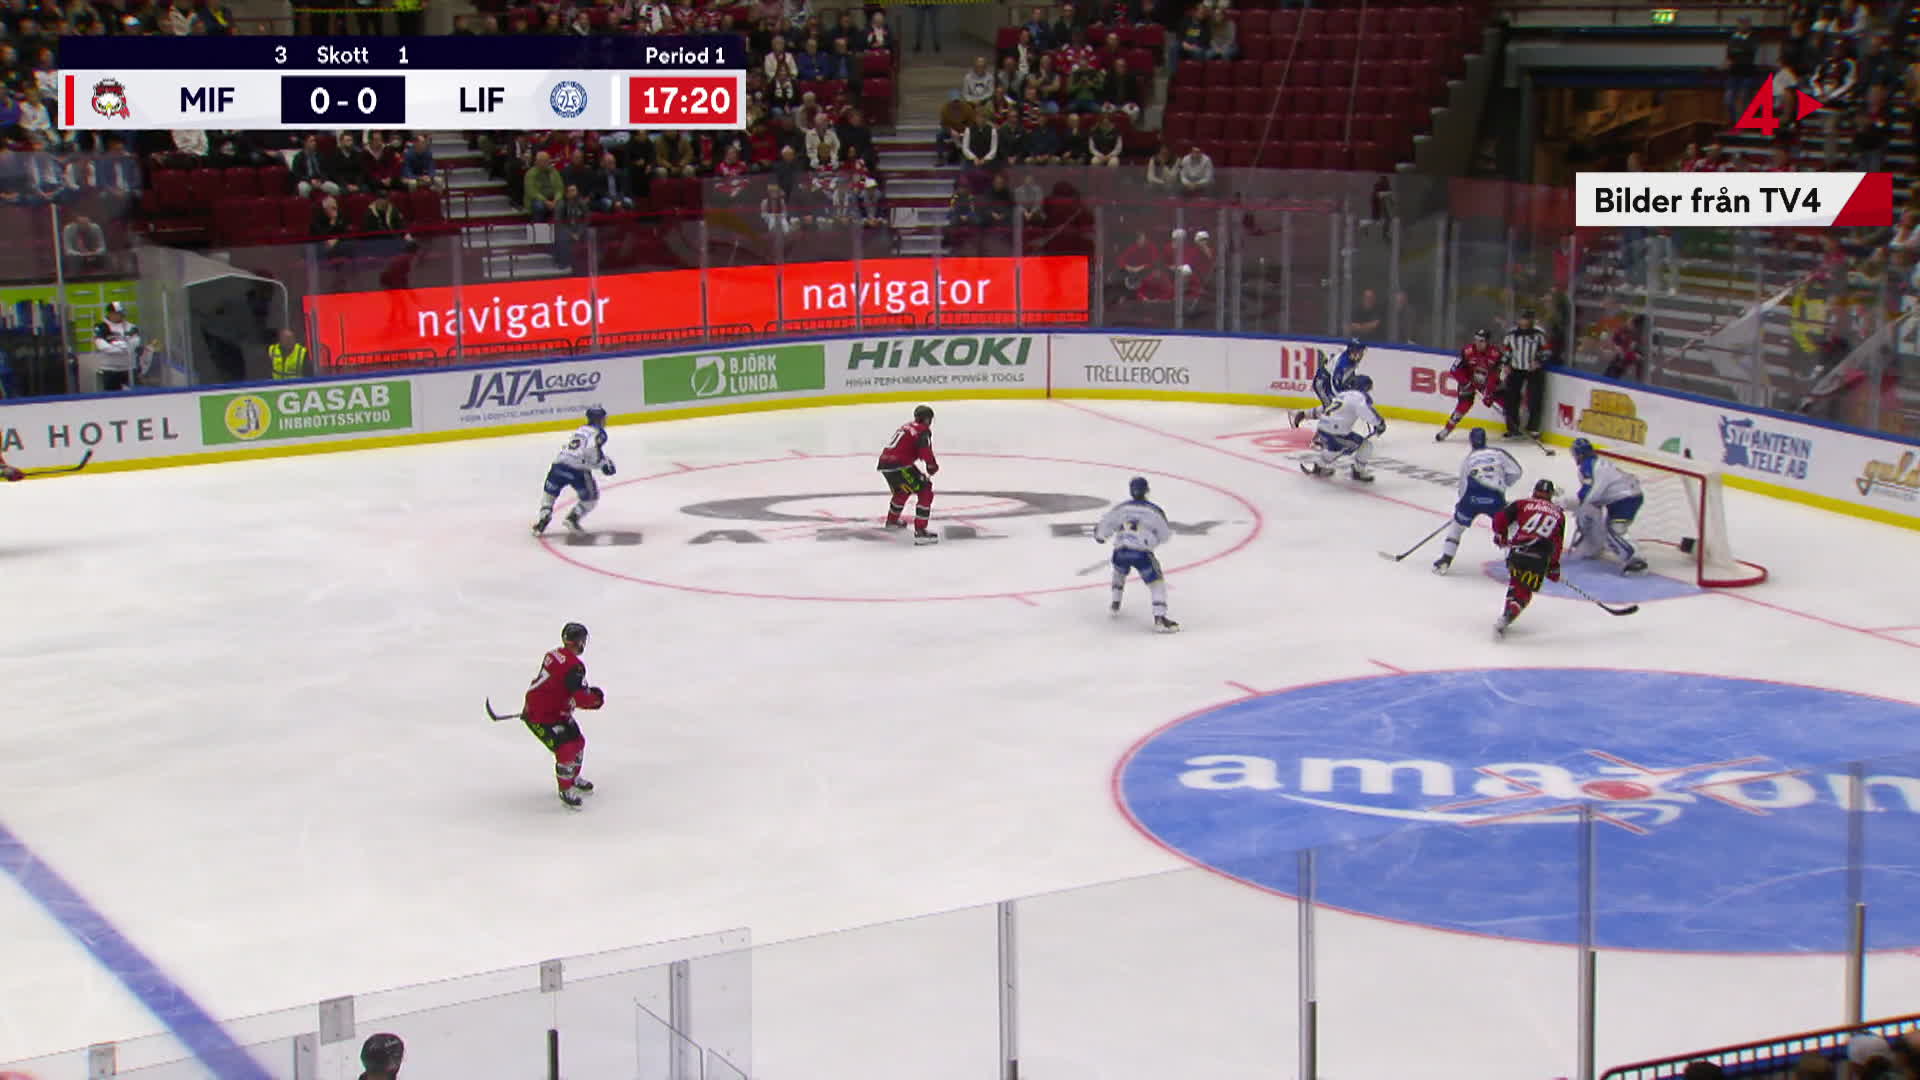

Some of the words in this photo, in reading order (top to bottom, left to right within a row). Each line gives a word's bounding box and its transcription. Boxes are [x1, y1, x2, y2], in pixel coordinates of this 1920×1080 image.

[803, 272, 991, 313] navigator
[418, 295, 610, 338] navigator
[729, 353, 777, 375] BJÖRK
[1085, 364, 1190, 385] TRELLEBORG
[460, 368, 545, 410] JATA
[545, 371, 601, 389] CARGO
[730, 374, 778, 394] LUNDA
[991, 372, 1025, 384] TOOLS
[277, 384, 390, 414] GASAB
[48, 416, 179, 449] HOTEL
[278, 409, 391, 431] INBROTTSSKYDD
[1752, 450, 1783, 475] TELE
[1521, 512, 1558, 538] 48
[1179, 752, 1920, 814] amazon
